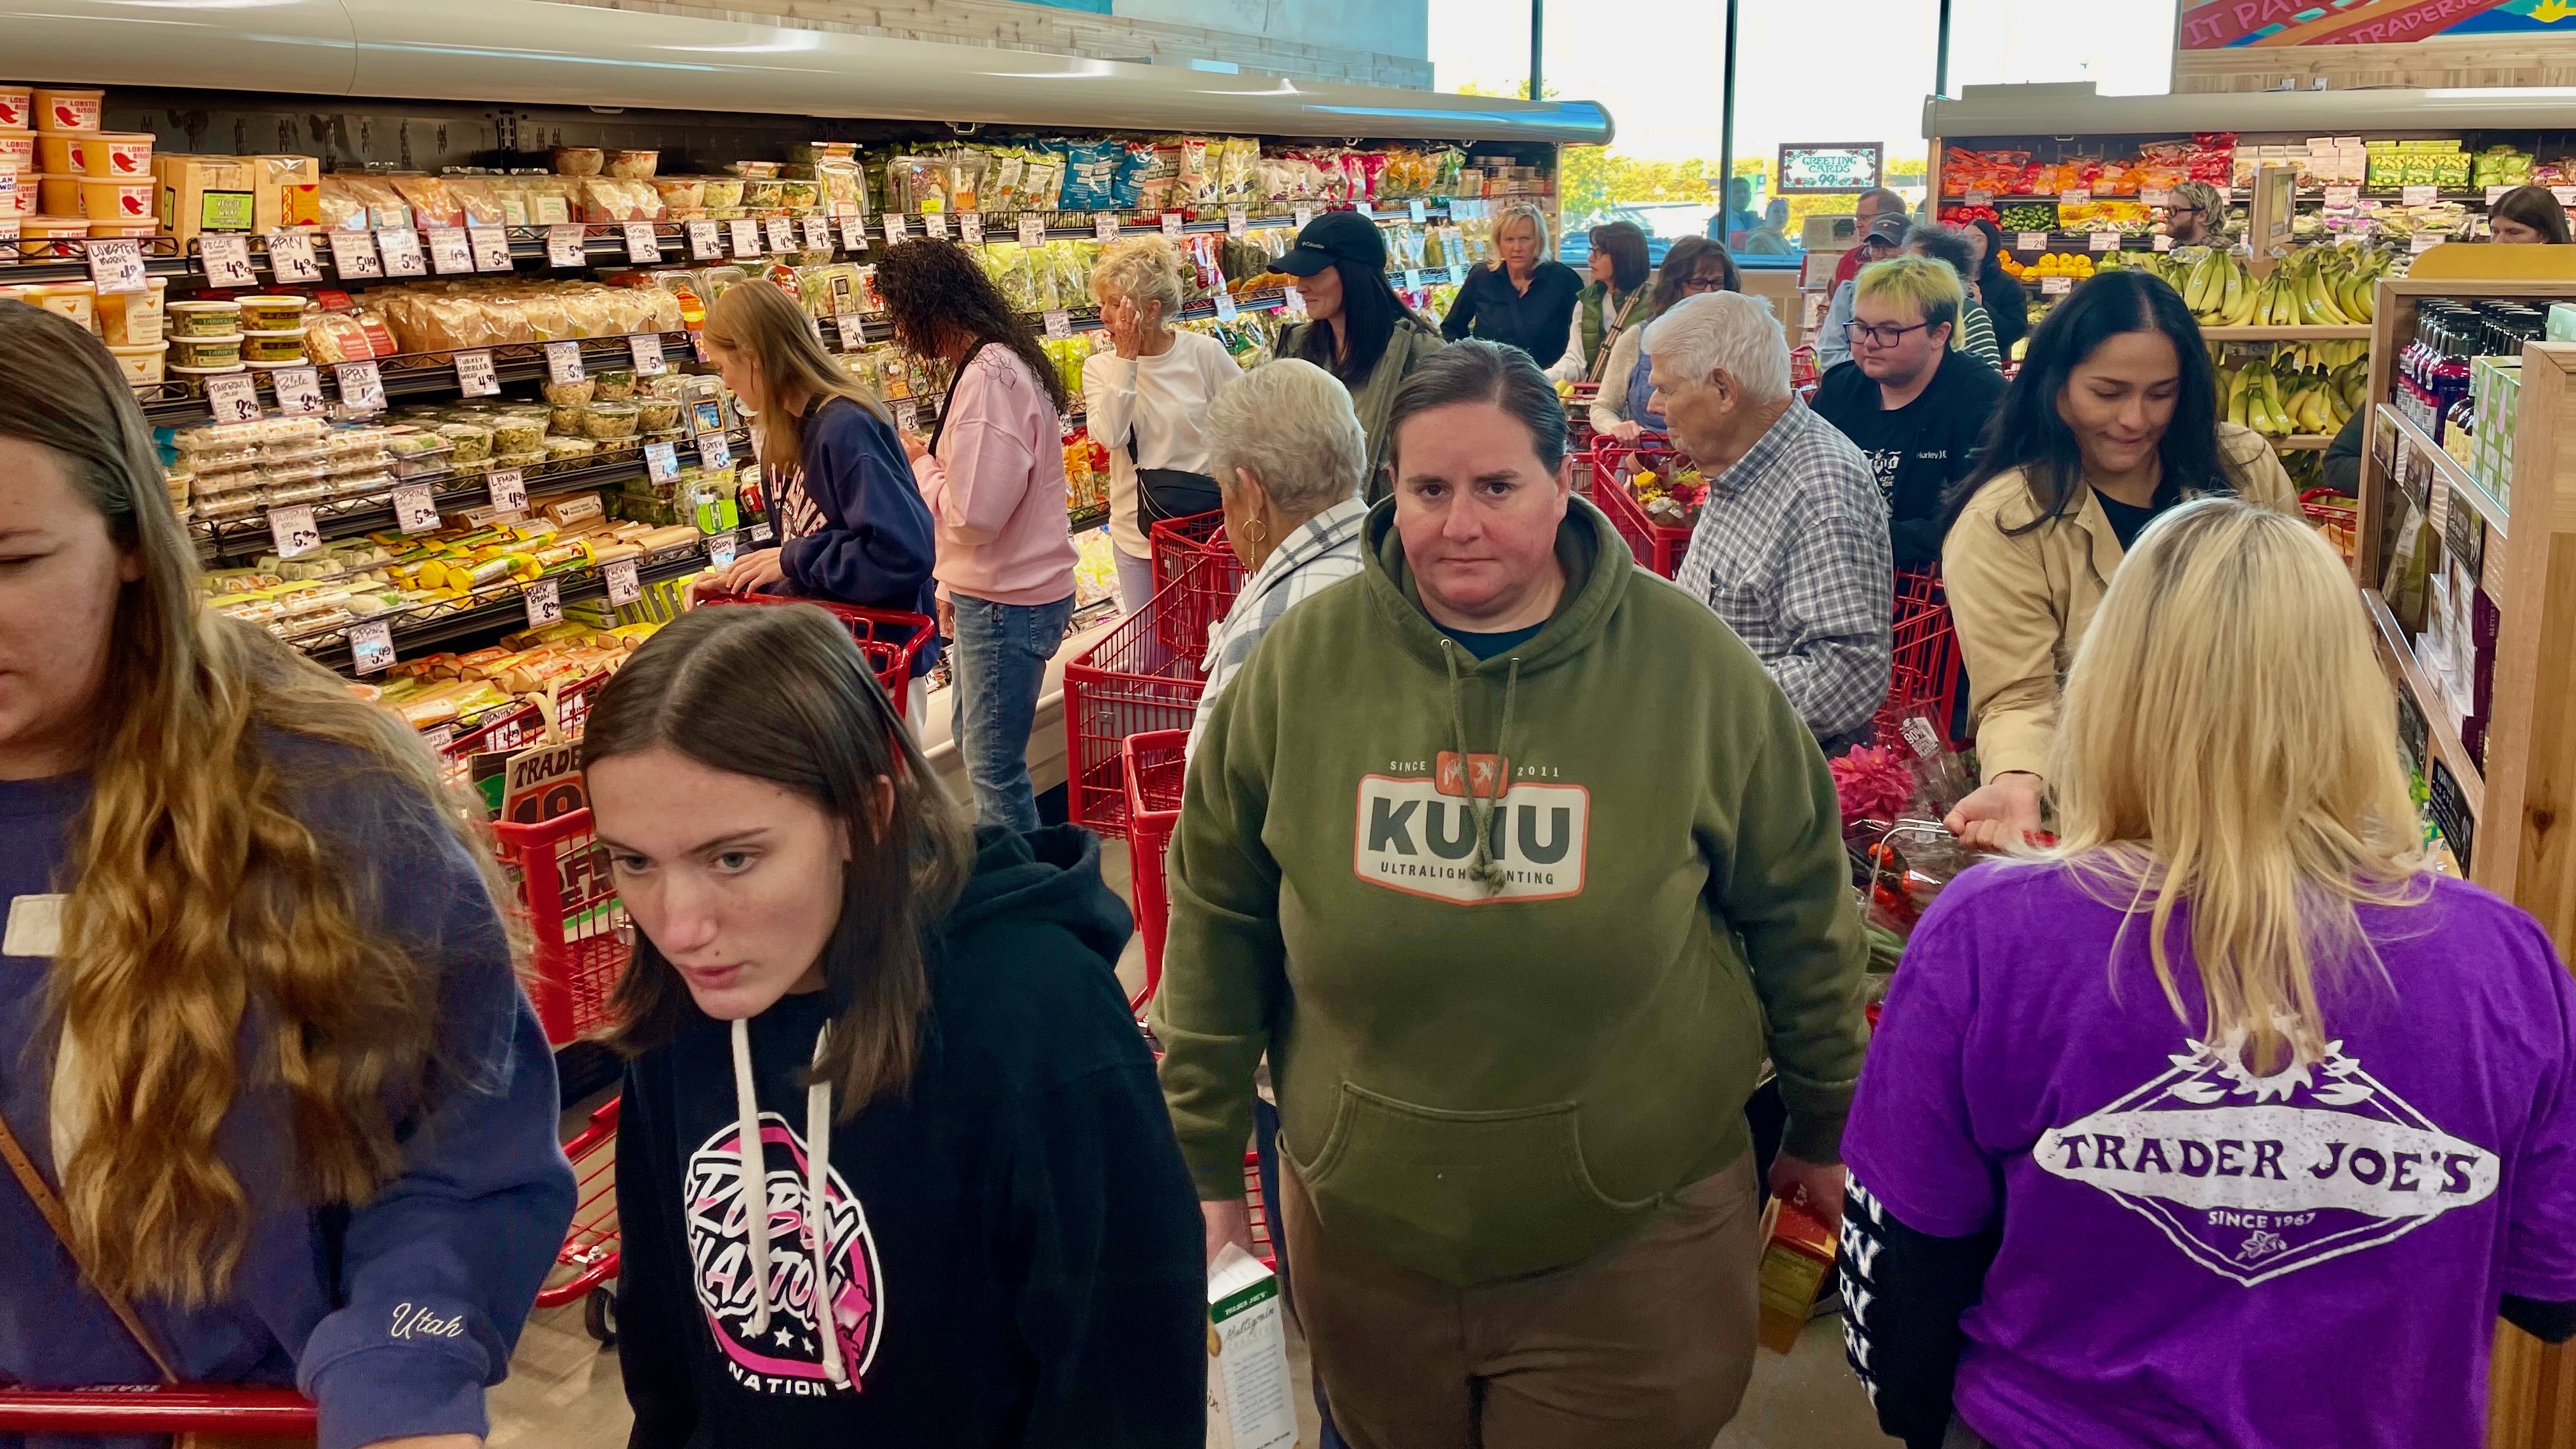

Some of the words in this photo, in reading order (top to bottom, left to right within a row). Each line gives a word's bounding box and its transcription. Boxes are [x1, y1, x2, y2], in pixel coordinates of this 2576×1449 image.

[2182, 13, 2223, 46] IT
[1802, 156, 1857, 165] GREETING
[203, 239, 233, 249] VEGGIE
[271, 235, 302, 250] SPICY
[458, 356, 483, 366] TURKEY
[341, 368, 369, 382] APPLE
[460, 372, 477, 380] WRAP
[479, 374, 496, 390] 4.99
[702, 440, 724, 452] GREEK
[491, 473, 518, 487] LEMON
[710, 540, 732, 553] Baby
[1390, 760, 1427, 771] SINCE
[1517, 766, 1560, 778] 2011
[1368, 796, 1570, 864] KUIU
[1381, 861, 1467, 880] ULTRALIGH
[2057, 1133, 2288, 1181] TRADER
[2306, 1142, 2482, 1195] JOE'S
[2208, 1210, 2268, 1230] SINCE
[2274, 1211, 2317, 1229] 1967
[390, 1303, 464, 1340] Utah
[728, 1360, 827, 1397] NATION
